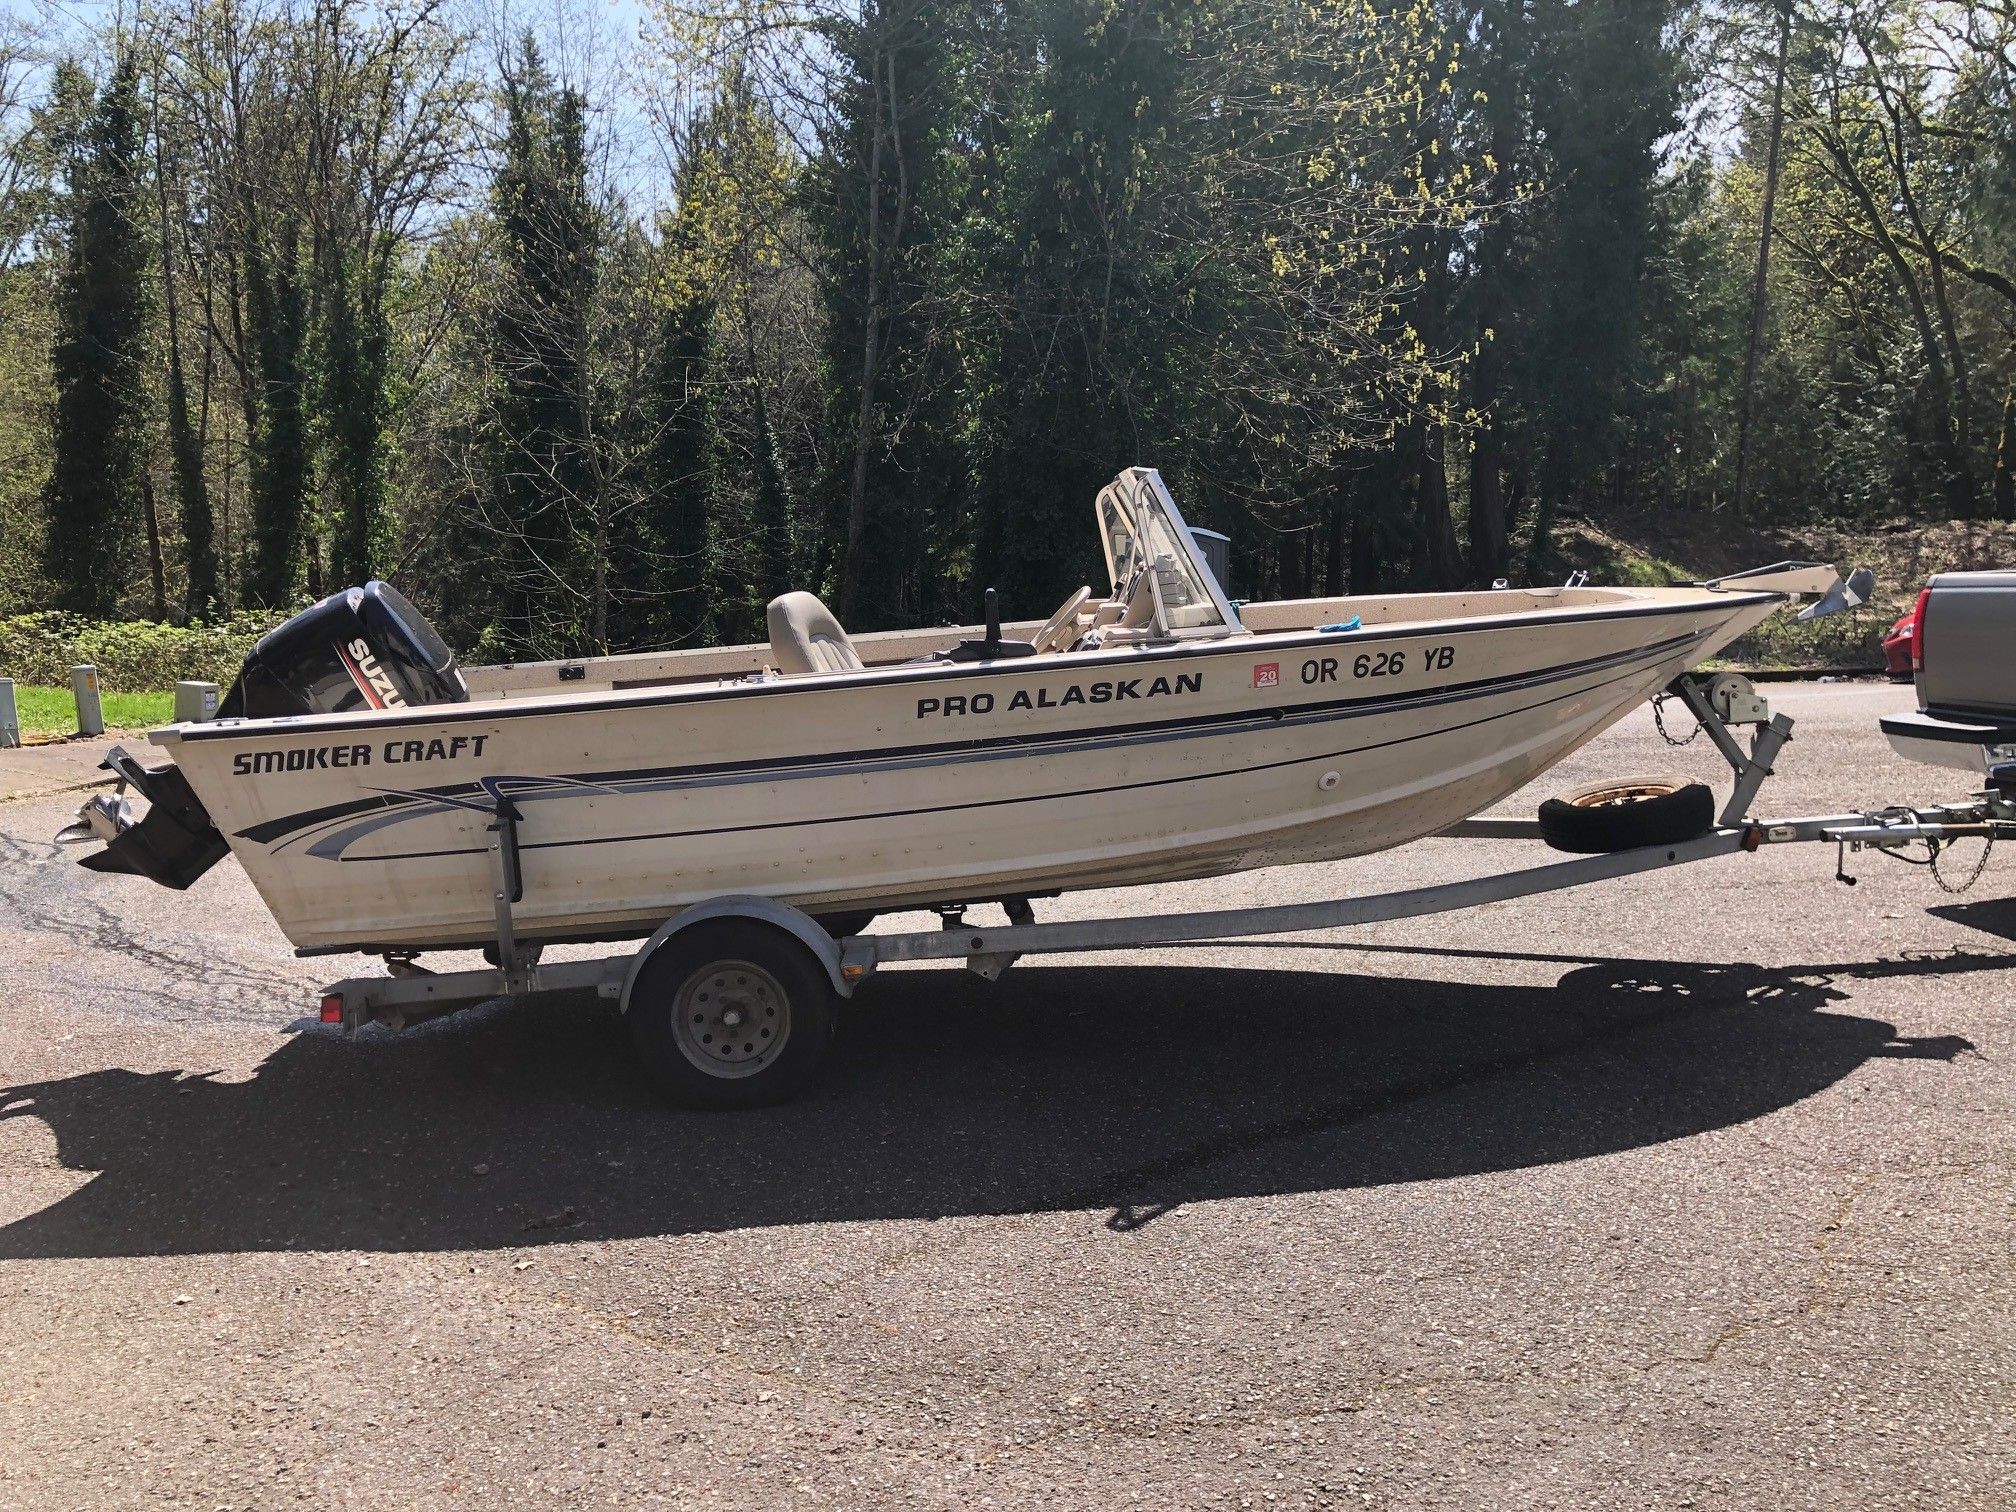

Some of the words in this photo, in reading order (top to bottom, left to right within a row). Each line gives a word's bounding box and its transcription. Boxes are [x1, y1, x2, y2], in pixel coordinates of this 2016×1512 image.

[347, 638, 409, 709] SUZU
[1259, 670, 1277, 682] 20
[1301, 657, 1339, 685] OR
[1352, 651, 1406, 679] 626
[1424, 645, 1455, 672] YB
[916, 693, 995, 719] PRO
[1007, 672, 1203, 711] ALASKAN
[232, 743, 372, 776] SMOKER
[383, 734, 489, 764] CRAFT
